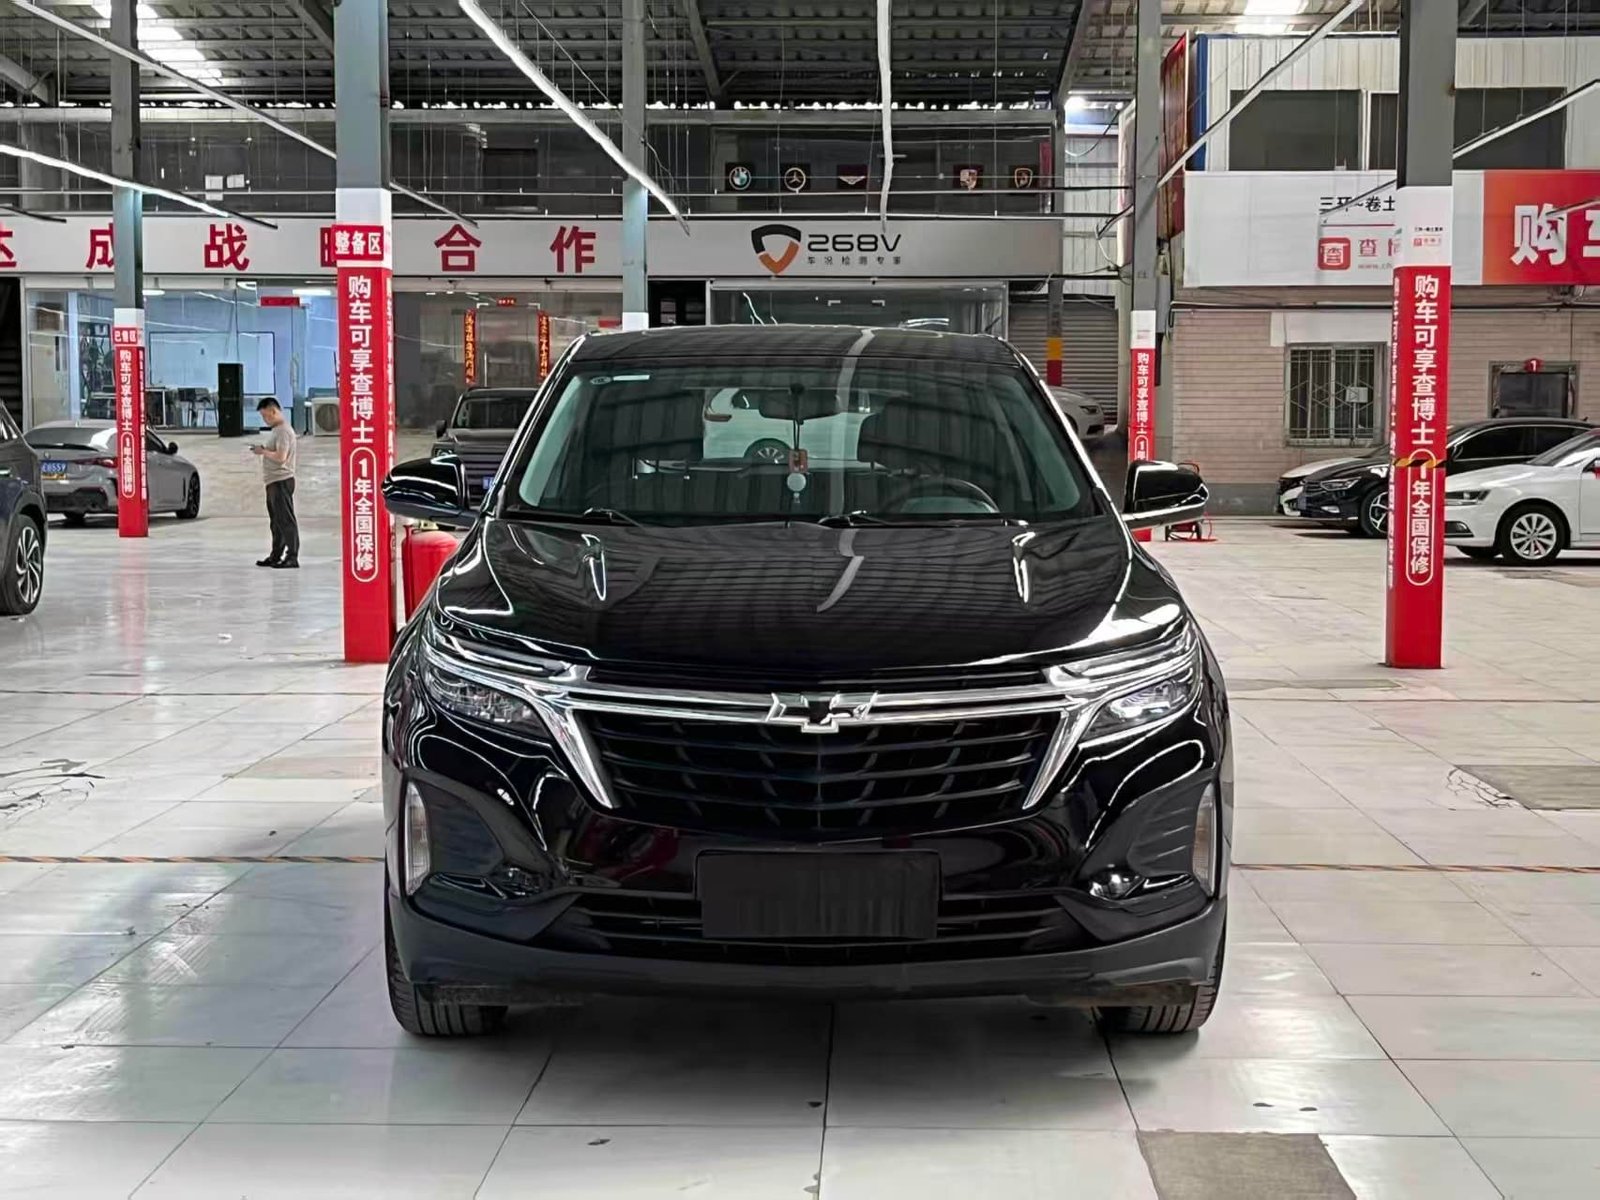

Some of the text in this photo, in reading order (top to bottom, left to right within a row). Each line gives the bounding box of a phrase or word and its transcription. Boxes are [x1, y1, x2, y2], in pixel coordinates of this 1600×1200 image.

[335, 230, 382, 256] 整备区
[807, 234, 901, 252] 268V
[807, 256, 901, 265] 车况检测专家
[120, 350, 133, 431] 购车可享查博士
[348, 275, 374, 444] 购车可享查博士
[1136, 353, 1150, 435] 购车可享查博士
[1411, 275, 1438, 445] 购车可享查博士
[1530, 360, 1537, 371] 1
[354, 457, 374, 571] 1年全国保修
[1410, 463, 1431, 574] 1年全国保修
